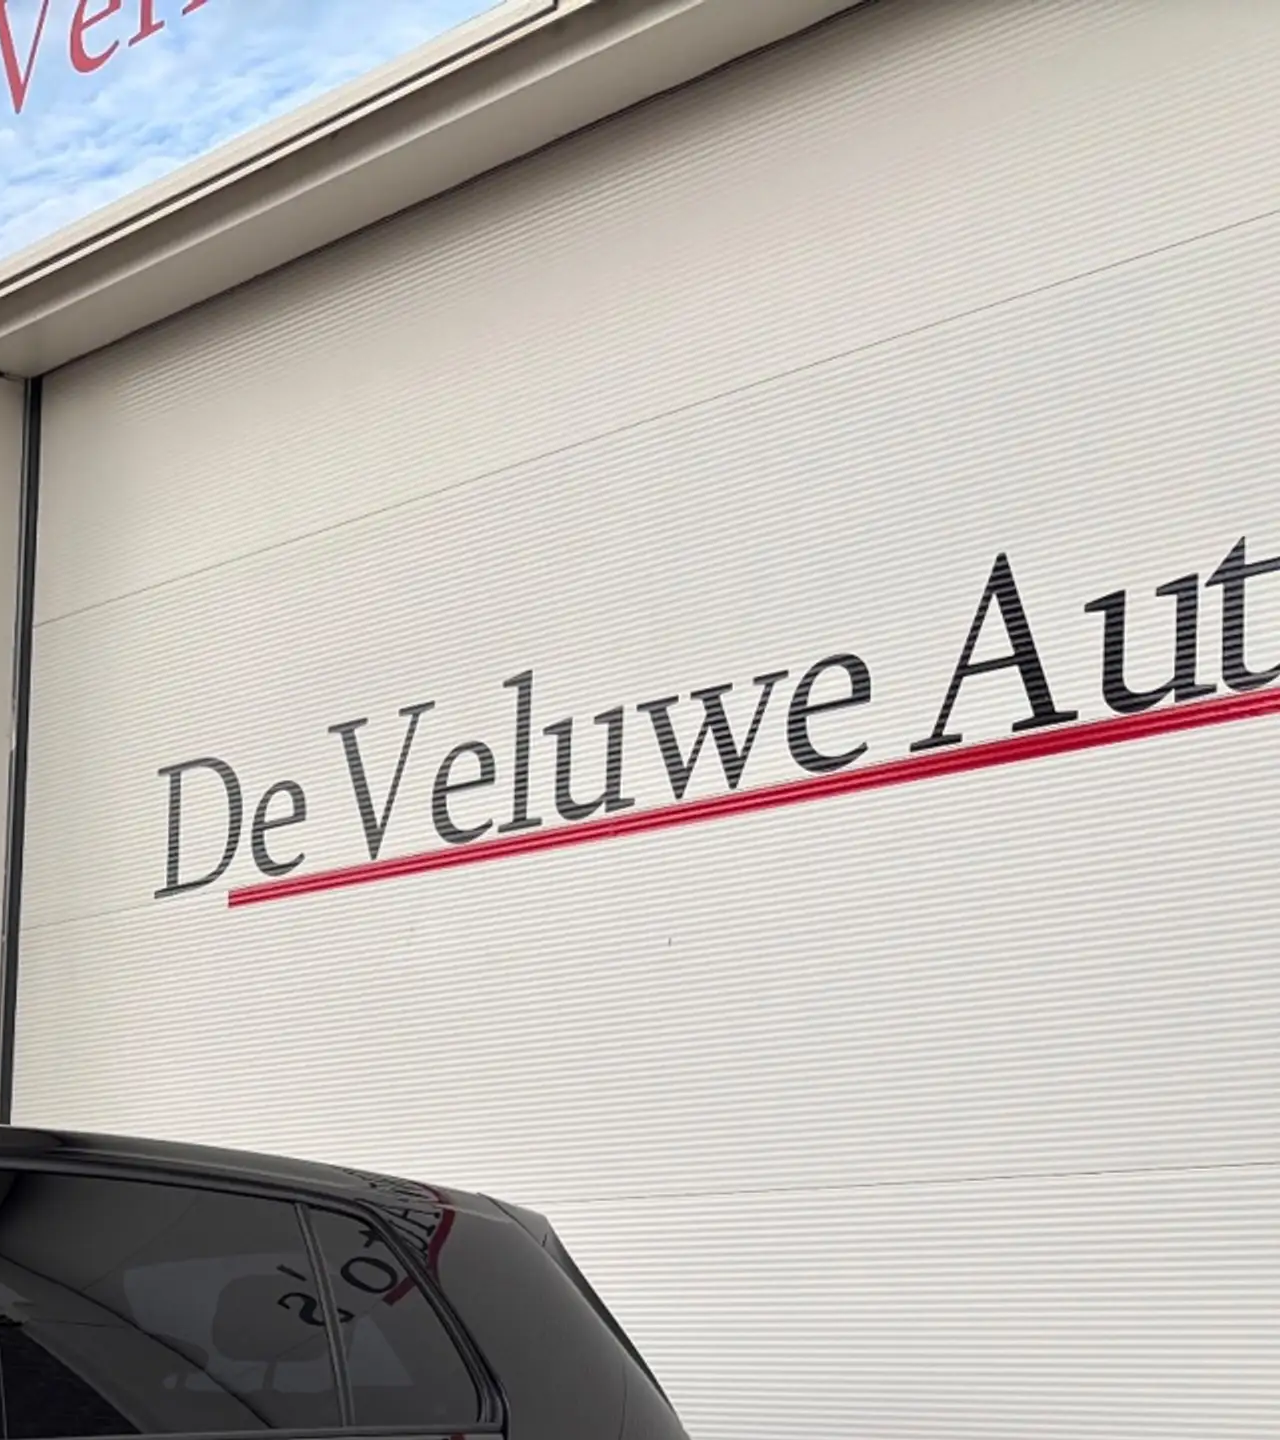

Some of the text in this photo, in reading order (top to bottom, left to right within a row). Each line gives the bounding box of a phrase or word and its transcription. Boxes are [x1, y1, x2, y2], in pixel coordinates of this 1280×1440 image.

[153, 535, 1280, 901] De Veluwe Aut
